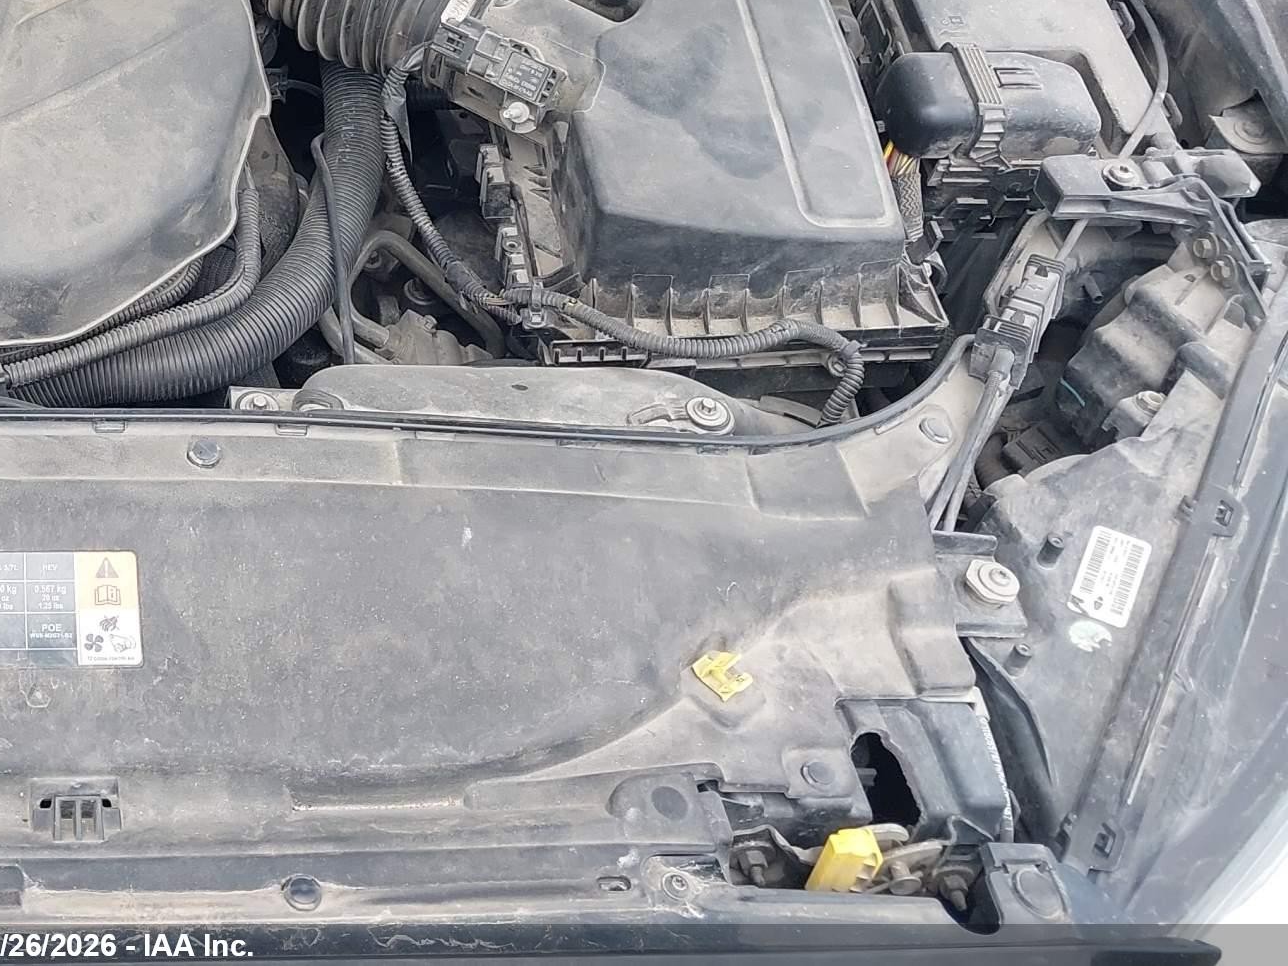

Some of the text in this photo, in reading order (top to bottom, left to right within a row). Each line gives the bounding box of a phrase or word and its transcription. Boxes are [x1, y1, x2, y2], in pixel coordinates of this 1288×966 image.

[6, 584, 17, 594] kg
[56, 584, 66, 594] kg
[41, 624, 62, 632] POE
